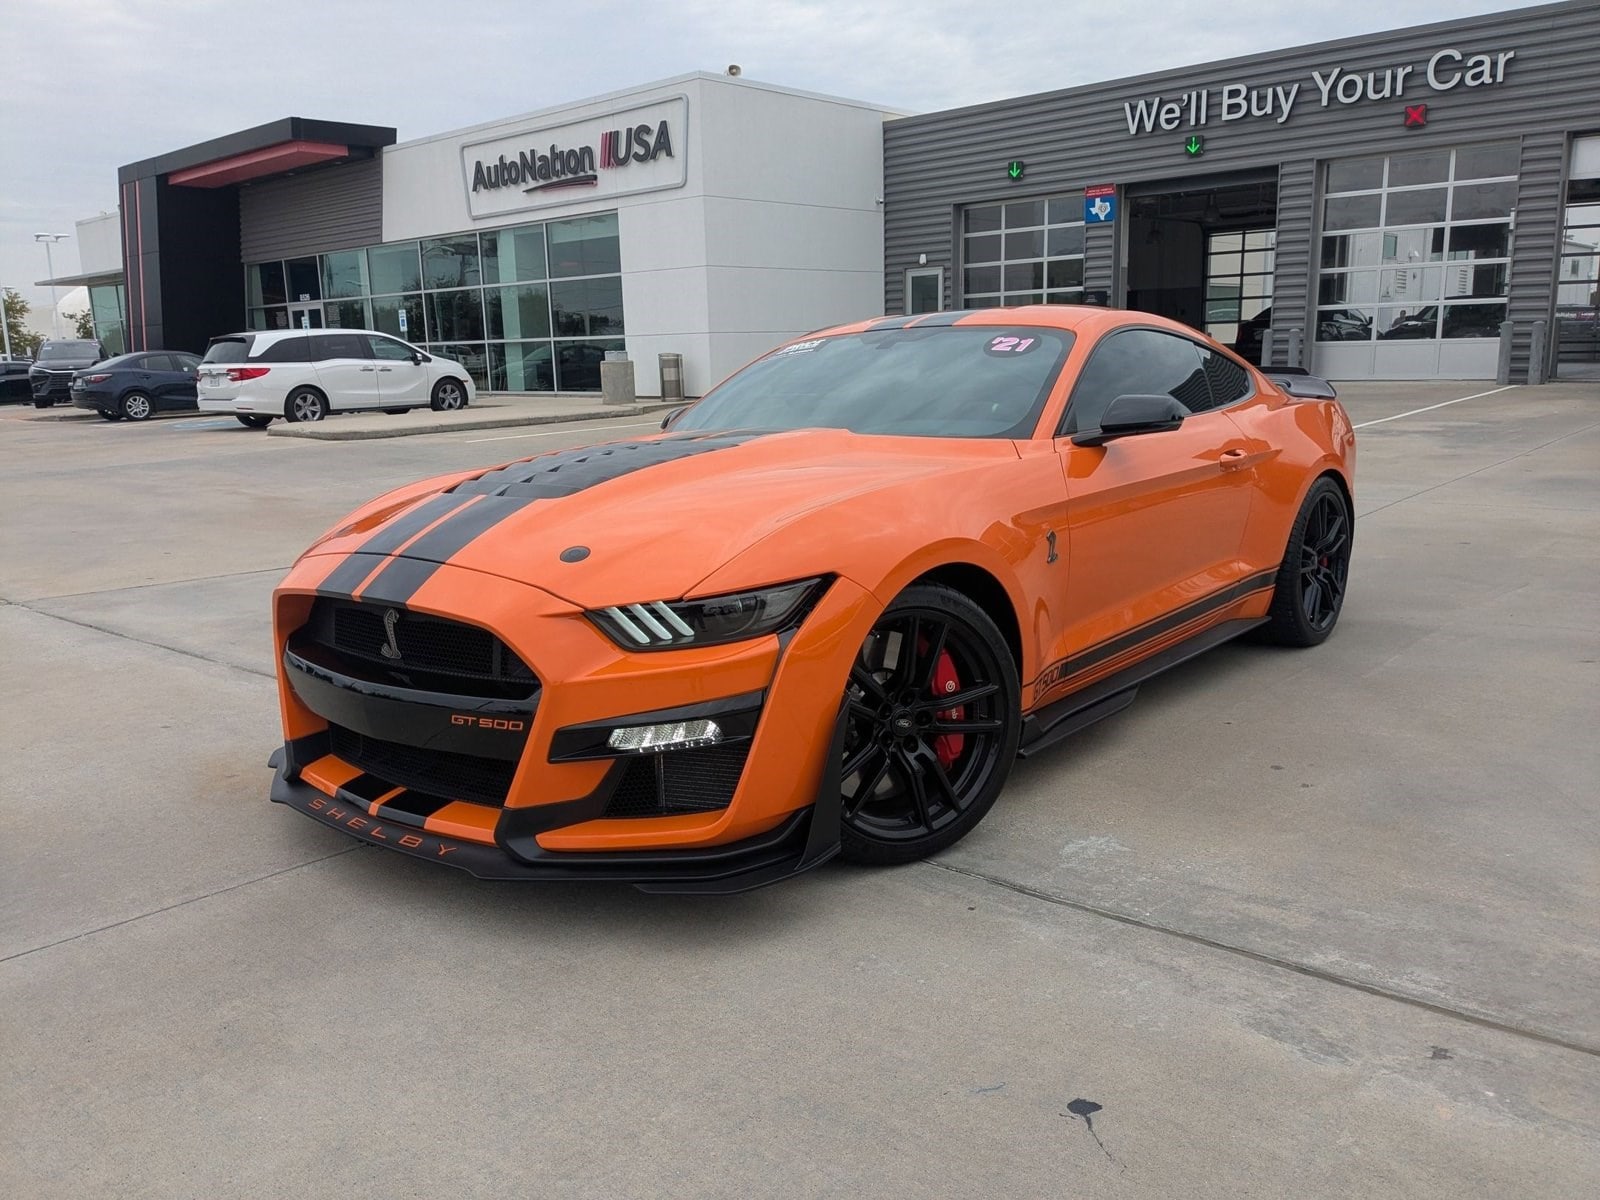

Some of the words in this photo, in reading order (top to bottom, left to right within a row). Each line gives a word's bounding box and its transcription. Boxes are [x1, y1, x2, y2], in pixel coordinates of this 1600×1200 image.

[1124, 88, 1208, 136] We'll
[1221, 82, 1300, 125] Buy
[1311, 65, 1413, 108] Your
[1426, 47, 1516, 92] Car
[472, 144, 596, 193] AutoNation
[612, 120, 674, 167] USA
[308, 797, 457, 856] SHELBY
